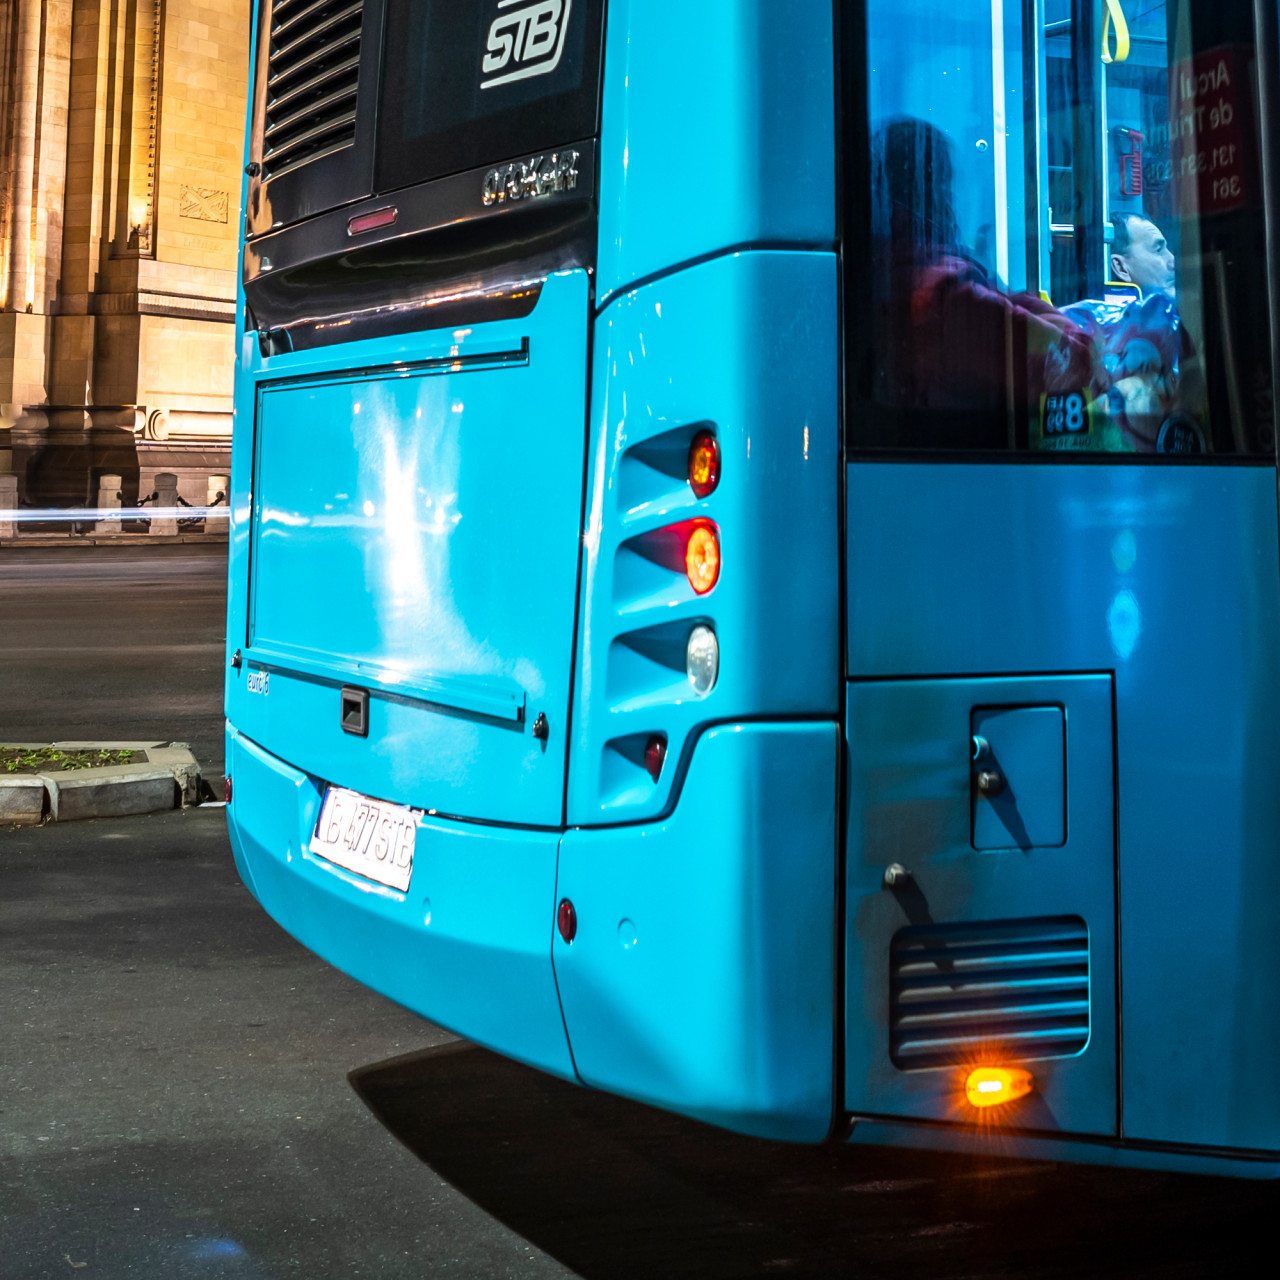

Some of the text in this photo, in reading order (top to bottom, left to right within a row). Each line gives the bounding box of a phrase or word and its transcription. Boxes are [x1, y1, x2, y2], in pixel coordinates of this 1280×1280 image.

[481, 149, 580, 206] OTOKAR
[326, 796, 417, 869] B 477 STB
